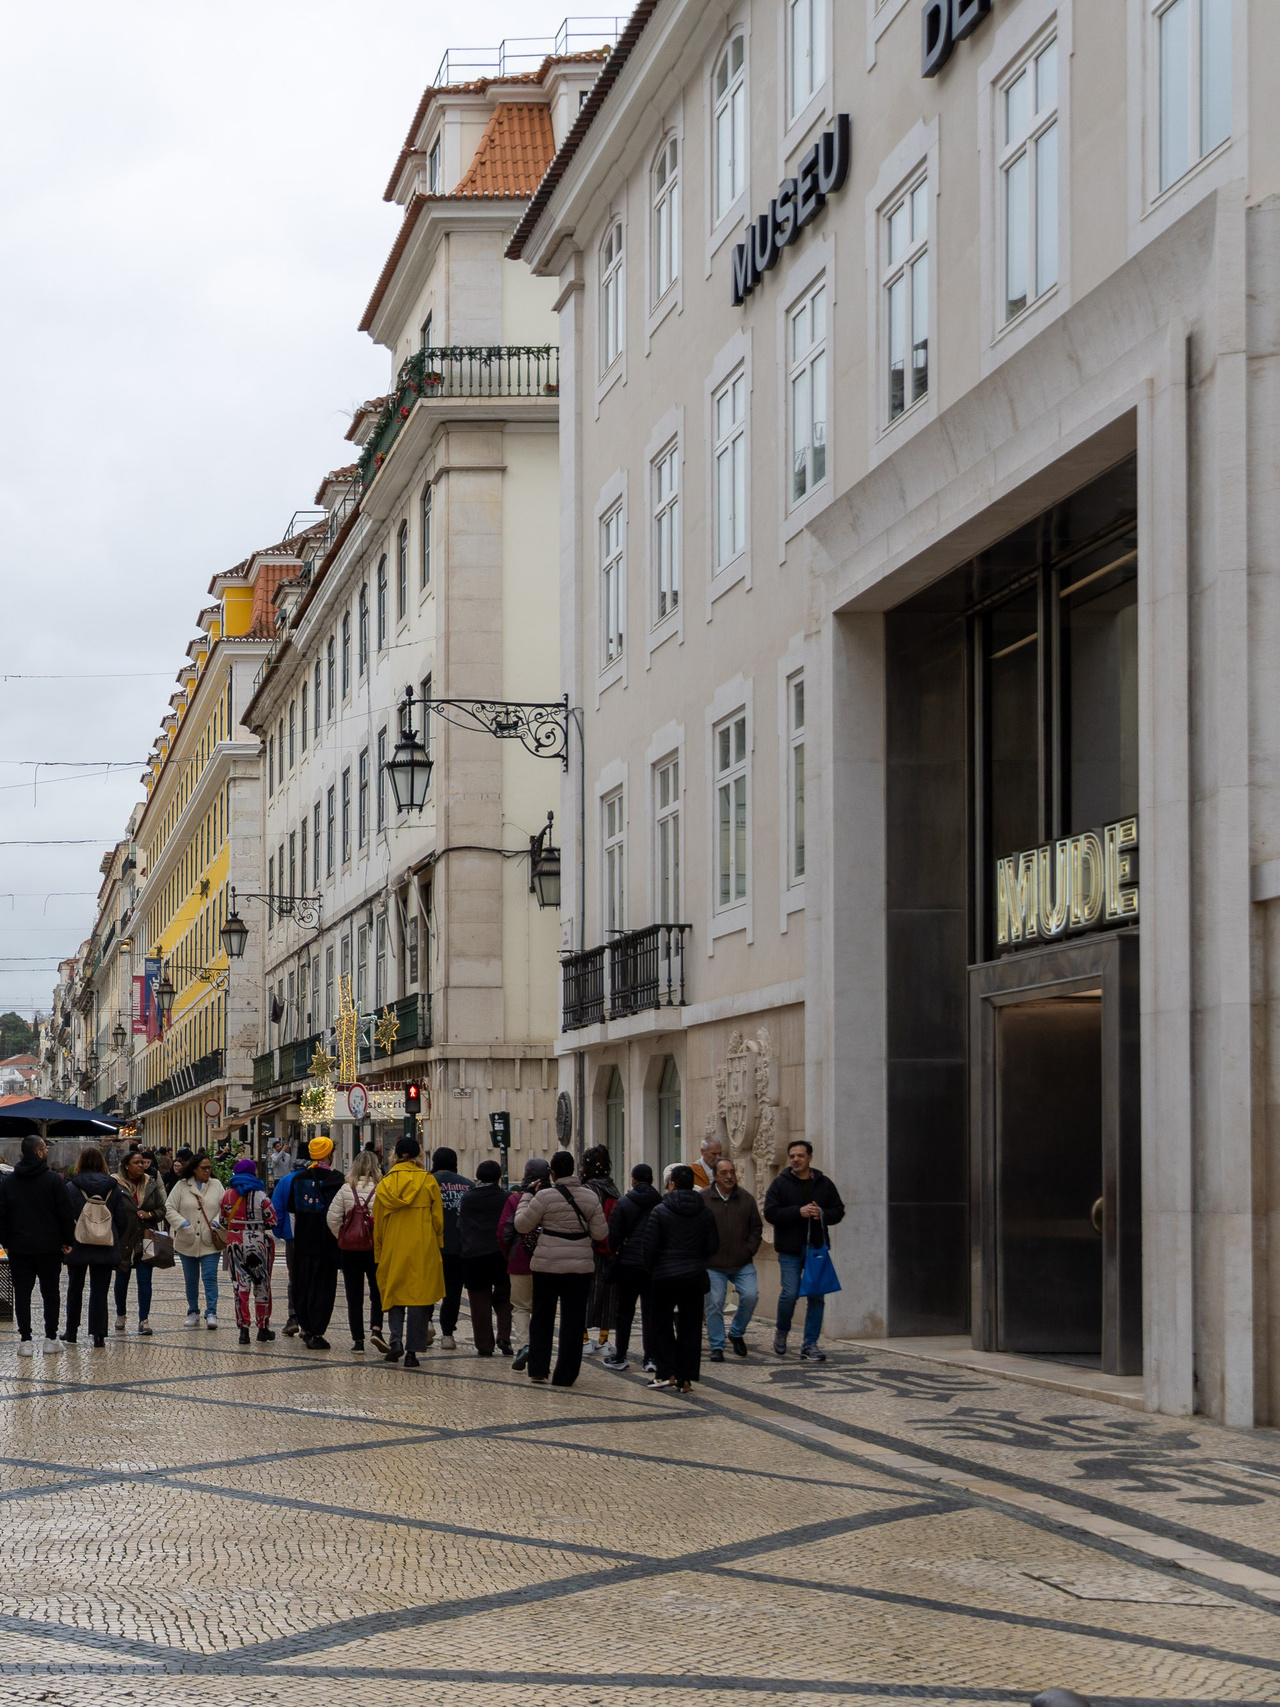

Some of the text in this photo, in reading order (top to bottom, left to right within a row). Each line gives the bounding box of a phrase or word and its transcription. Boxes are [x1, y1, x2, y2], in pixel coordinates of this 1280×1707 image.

[731, 113, 850, 307] MUSEU
[997, 817, 1139, 945] MUDE
[441, 1182, 470, 1190] Matter
